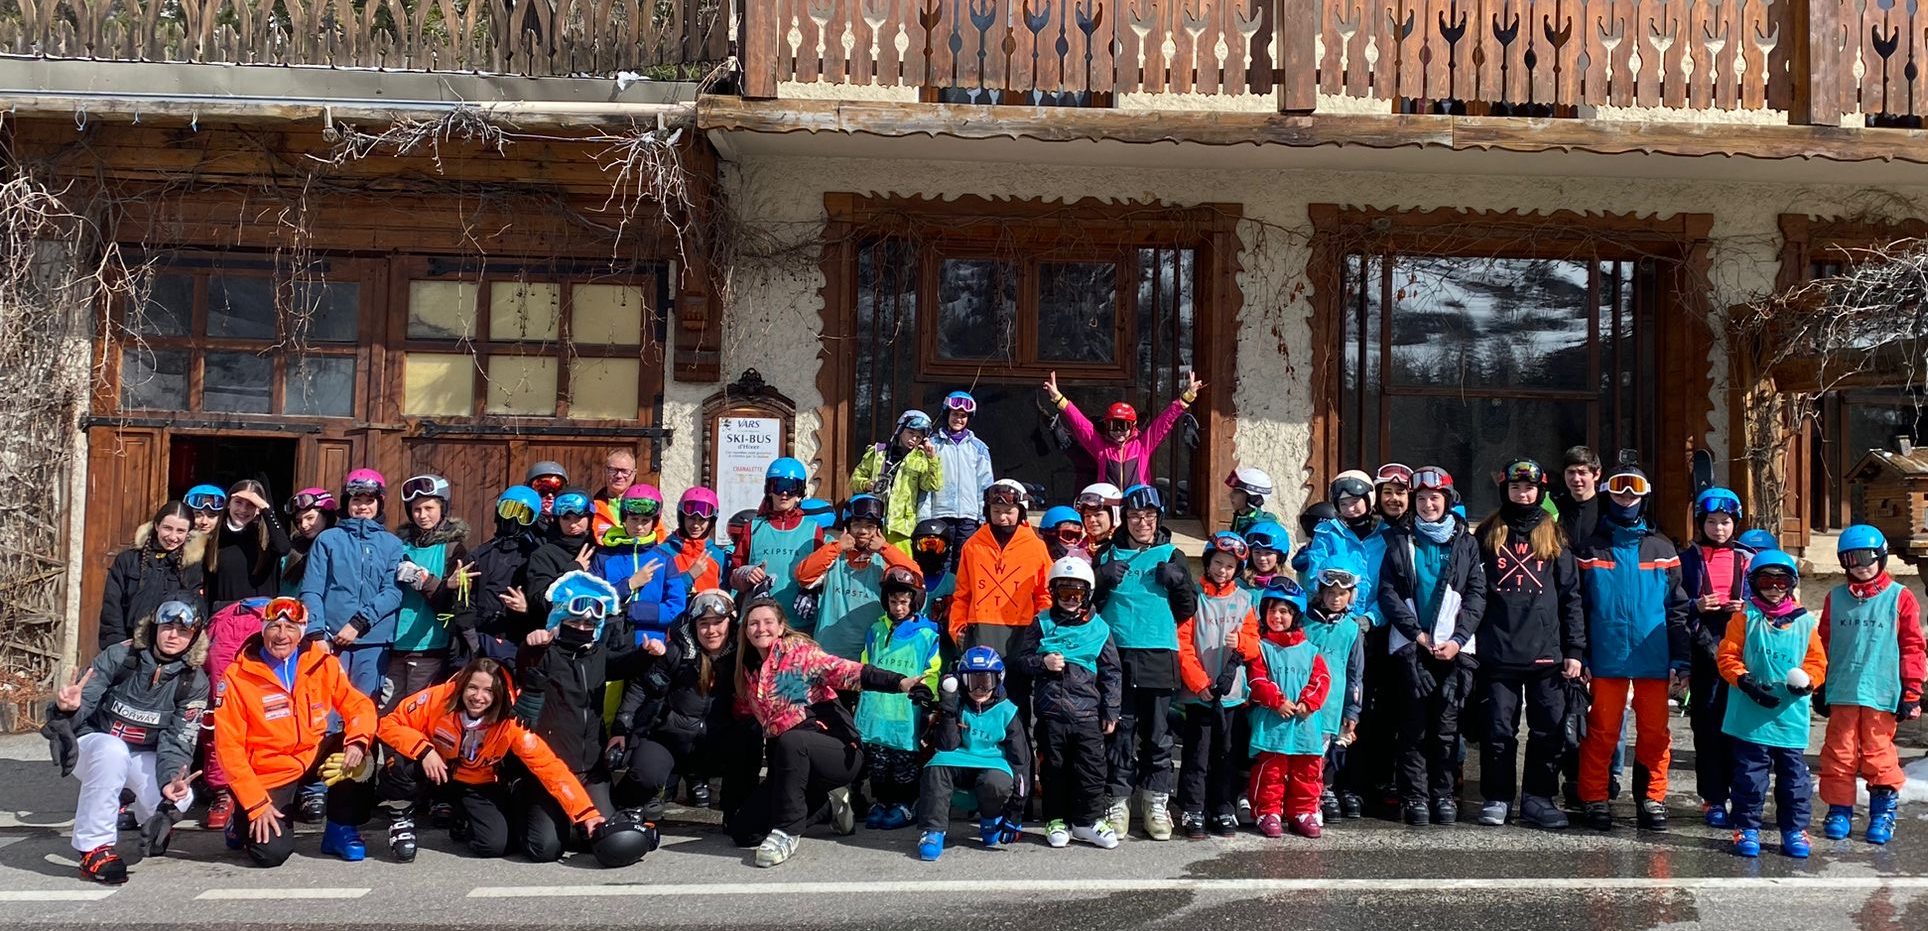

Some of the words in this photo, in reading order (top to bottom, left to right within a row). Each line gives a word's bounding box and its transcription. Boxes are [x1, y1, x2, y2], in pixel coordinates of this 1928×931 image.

[737, 419, 760, 428] VARS
[726, 433, 772, 443] SKI-BUS
[763, 547, 800, 557] KIPSTA
[1514, 542, 1529, 555] W
[994, 563, 1006, 575] W
[1497, 557, 1507, 569] S
[1536, 560, 1544, 572] T
[978, 579, 986, 590] S
[1013, 580, 1020, 592] T
[1515, 574, 1524, 586] T
[994, 595, 1001, 607] T
[1839, 618, 1884, 629] KIPSTA
[877, 655, 915, 670] KIPSTA
[113, 702, 157, 723] NORWAY
